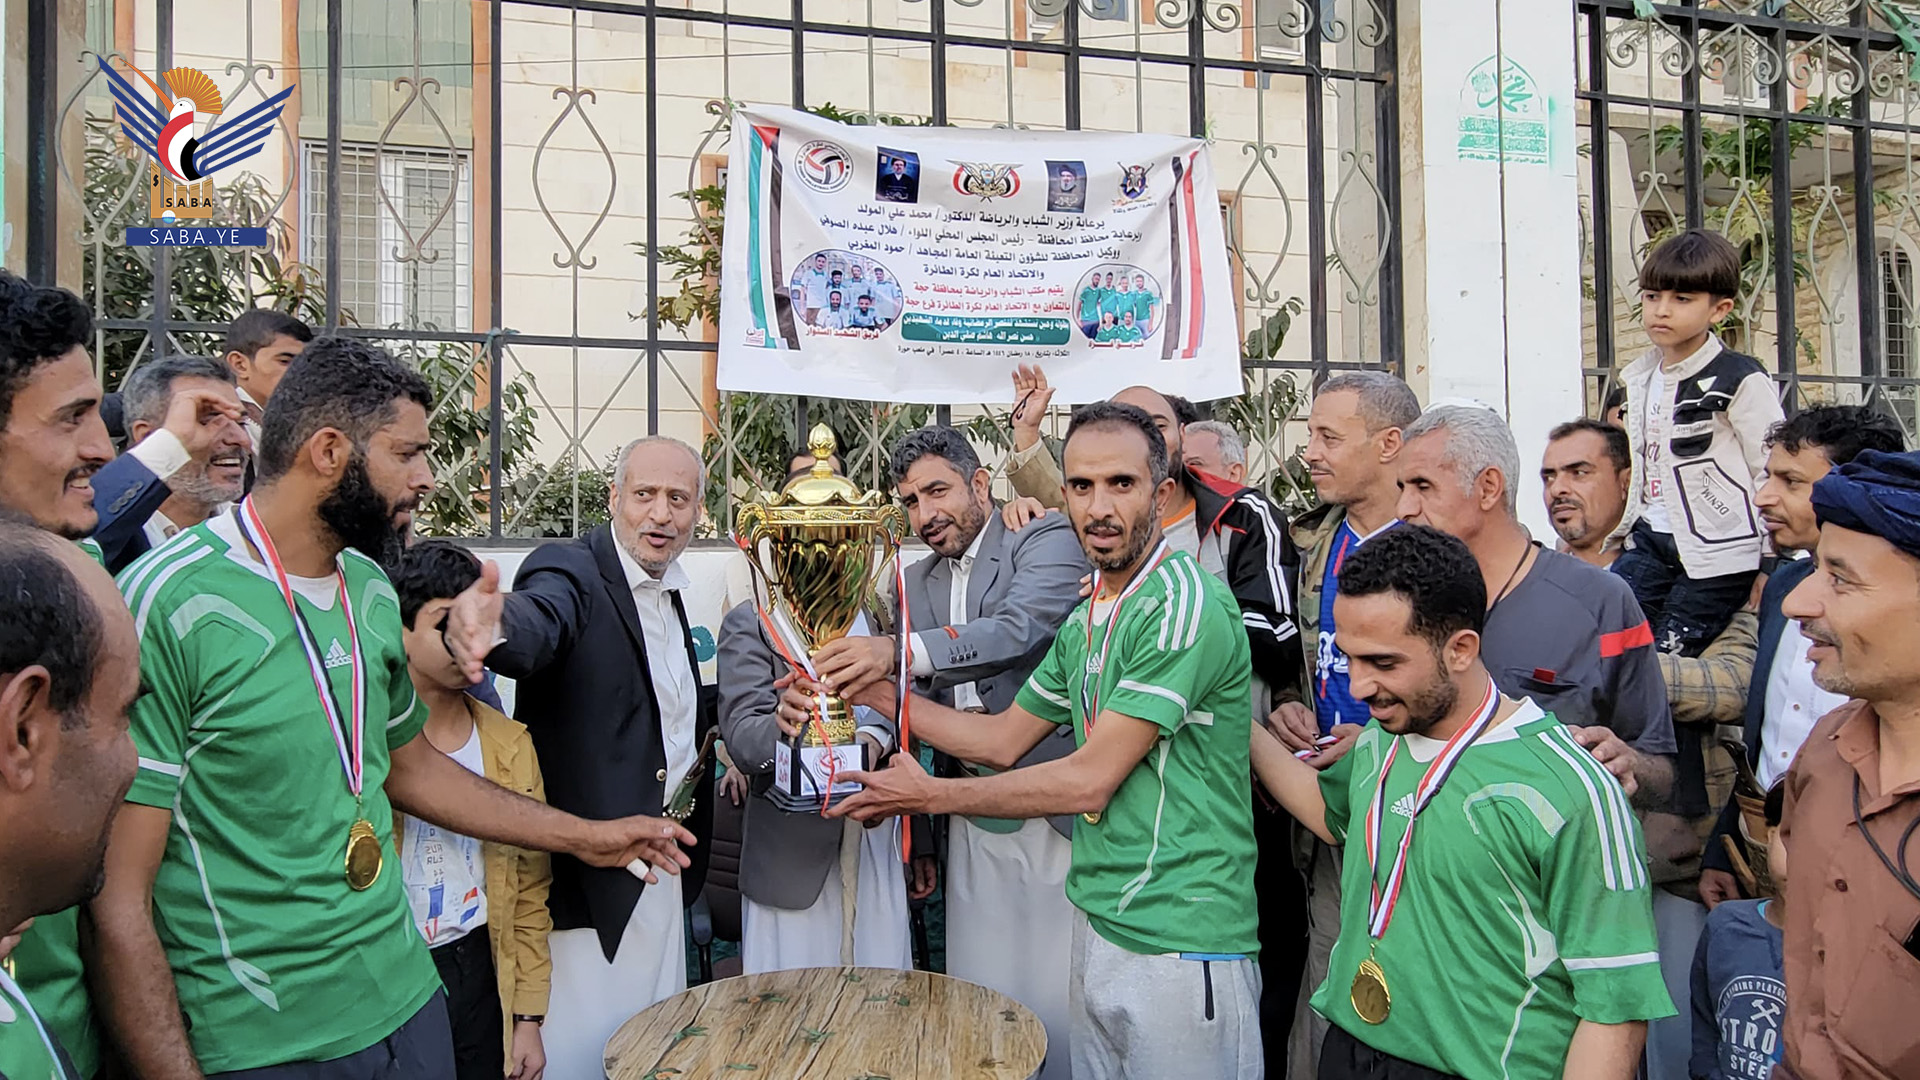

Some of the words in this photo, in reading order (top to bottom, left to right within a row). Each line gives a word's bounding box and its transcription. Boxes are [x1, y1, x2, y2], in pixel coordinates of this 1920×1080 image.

[858, 204, 885, 216] المولد
[888, 206, 905, 221] علي
[909, 209, 932, 219] محمد
[942, 210, 975, 223] الدكتور
[979, 212, 1019, 228] والرياضة
[1023, 214, 1053, 228] الشباب
[819, 216, 849, 230] الصوفي
[852, 222, 875, 232] عبده
[1056, 218, 1073, 230] وزير
[1076, 217, 1105, 231] برعاية
[878, 224, 898, 236] هلال
[909, 228, 931, 239] اللواء
[935, 229, 963, 243] المحلي
[966, 232, 998, 244] المجلس
[1001, 234, 1024, 246] رئيس
[1037, 234, 1077, 245] المحافظة
[1080, 234, 1109, 244] محافظ
[884, 244, 905, 255] حمود
[916, 246, 951, 259] المجاهد
[954, 249, 981, 261] العامة
[1052, 250, 1093, 261] المحافظة
[1098, 246, 1120, 260] ووكيل
[984, 250, 1015, 264] التعبئة
[923, 263, 957, 277] الطائرة
[960, 266, 979, 279] لكرة
[983, 268, 1004, 279] العام
[1008, 269, 1045, 280] والاتحاد
[914, 281, 929, 292] حجة
[932, 284, 963, 297] بمحافظة
[965, 286, 998, 298] والرياضة
[1000, 287, 1024, 297] الشباب
[1027, 286, 1045, 296] مكتب
[905, 295, 920, 307] حجة
[922, 299, 935, 310] فرع
[937, 299, 964, 311] الطائرة
[966, 300, 982, 313] لكرة
[984, 300, 1002, 312] العام
[1005, 300, 1030, 311] الاتحاد
[1032, 304, 1041, 313] مع
[1044, 301, 1071, 315] بالتعاون
[834, 329, 861, 339] الشهيد
[862, 330, 879, 340] فريق
[1701, 489, 1730, 516] DENIM
[324, 654, 353, 669] adidas
[1390, 805, 1414, 819] adida
